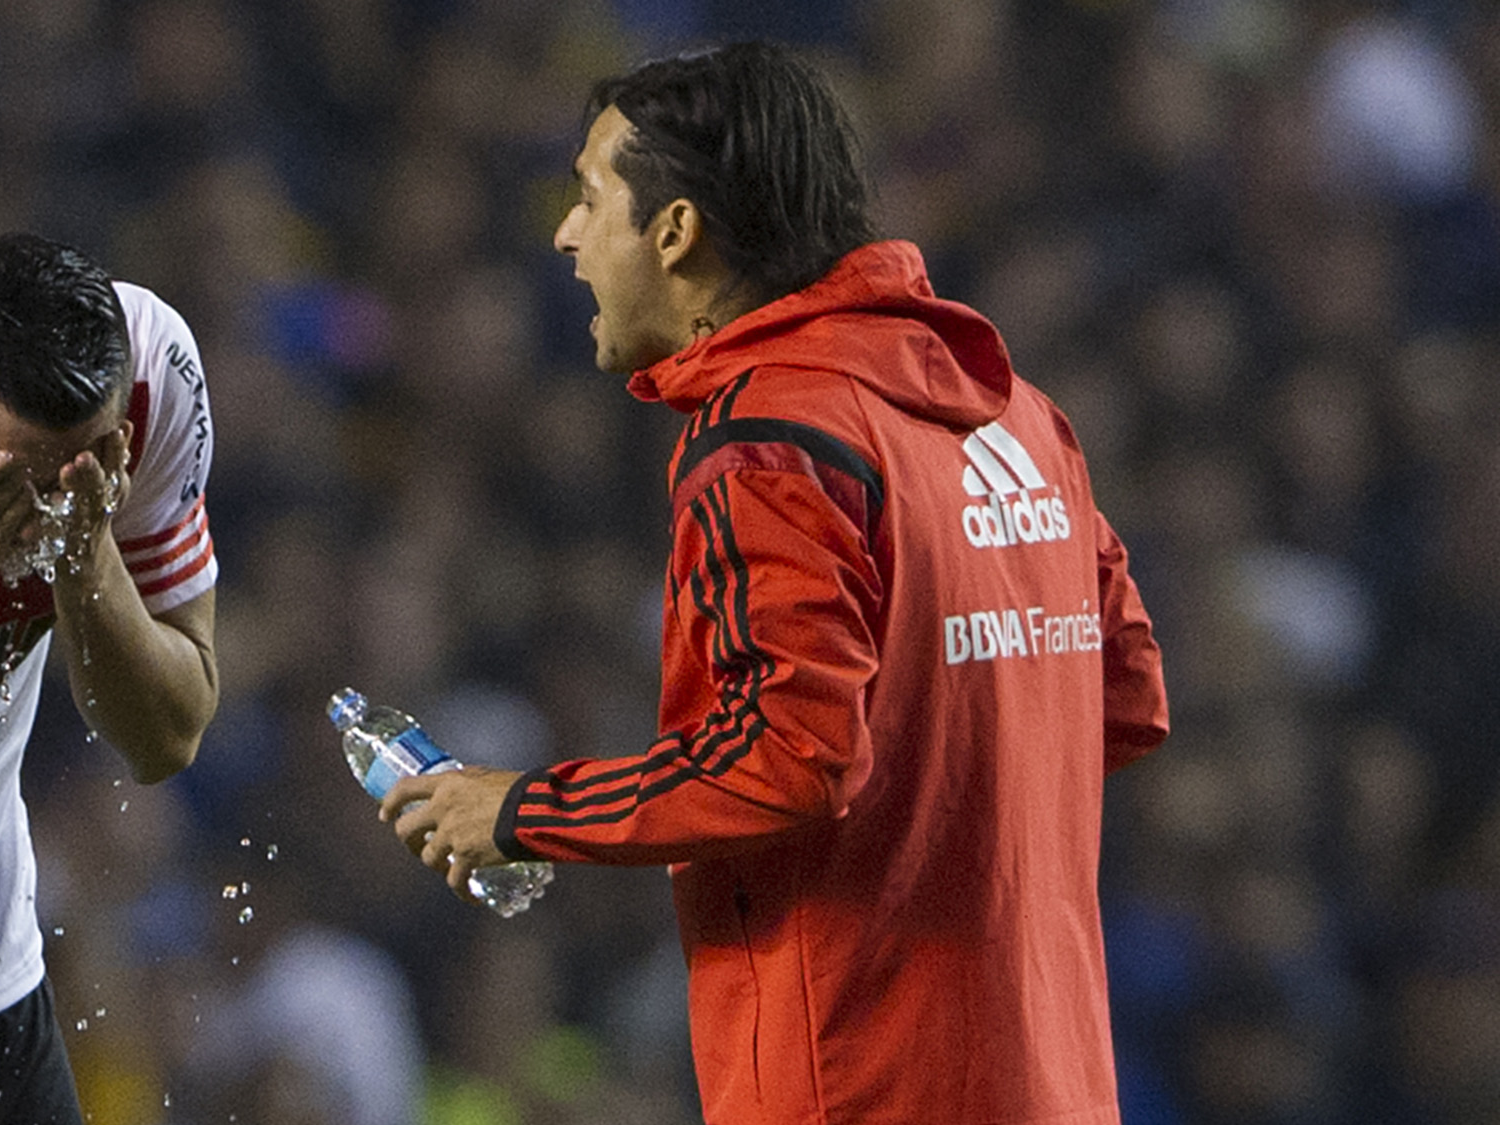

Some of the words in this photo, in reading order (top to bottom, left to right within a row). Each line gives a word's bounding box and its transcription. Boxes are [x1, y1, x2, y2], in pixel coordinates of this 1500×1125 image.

[961, 486, 1071, 549] adidas
[944, 608, 1028, 665] BBVA
[1026, 598, 1102, 656] Francés
